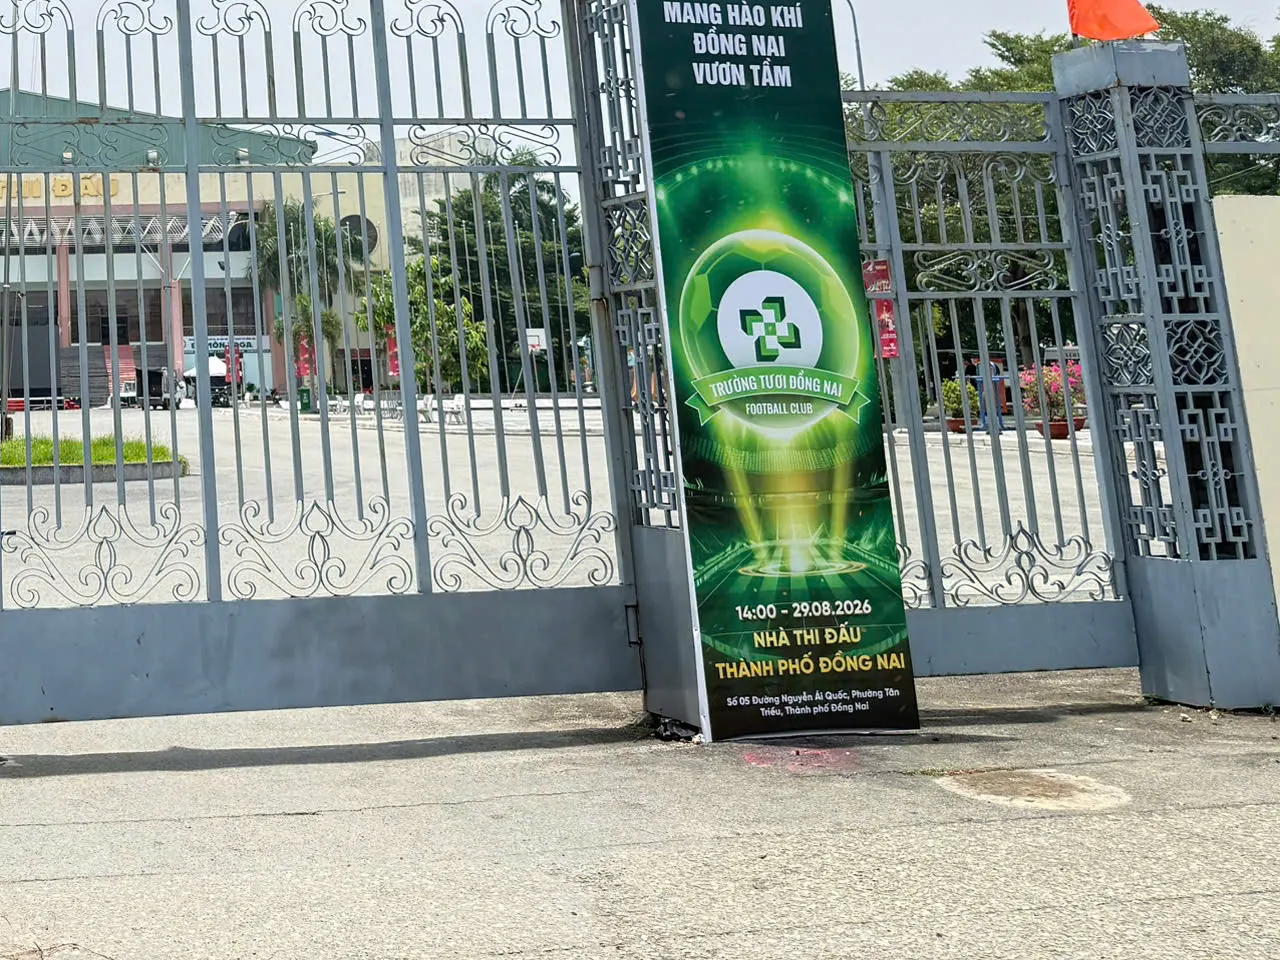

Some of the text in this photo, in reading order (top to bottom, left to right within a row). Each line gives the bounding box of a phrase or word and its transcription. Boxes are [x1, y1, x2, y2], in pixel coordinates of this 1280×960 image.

[663, 0, 803, 28] MANG HÀO KHÍ
[693, 26, 785, 57] ĐỒNG NAI
[692, 57, 792, 87] VƯƠN TẦM
[710, 370, 843, 398] TRƯỜNG TƯƠI ĐỒNG NAI
[745, 402, 813, 414] FOOTBALL CLUB
[736, 604, 776, 621] 14:00
[792, 599, 872, 618] 29.08.2026
[753, 621, 861, 648] NHÀ THI ĐẤU
[715, 650, 905, 680] THÀNH PHỐ ĐỒNG NAI
[727, 696, 737, 706] Số
[739, 696, 750, 706] 05
[752, 695, 780, 708] Đường
[815, 690, 824, 701] Ái
[825, 689, 850, 702] Quốc,
[852, 688, 883, 702] Phường
[885, 688, 900, 698] Tân
[785, 704, 812, 715] Thành
[813, 703, 829, 715] phố
[856, 702, 869, 711] Nai
